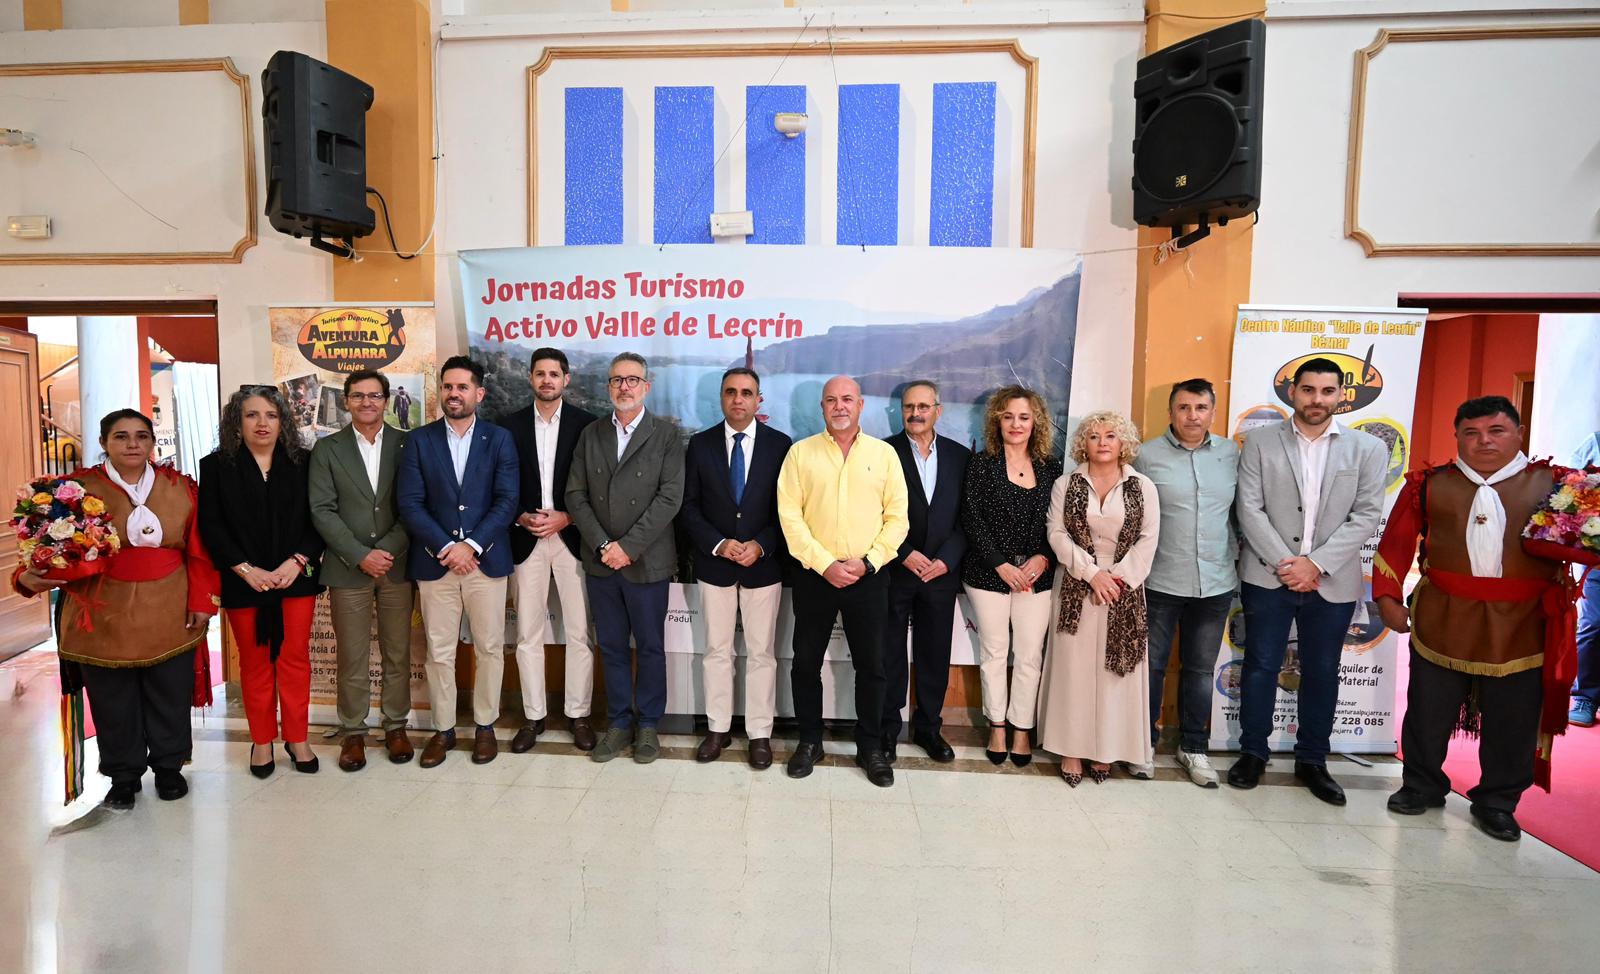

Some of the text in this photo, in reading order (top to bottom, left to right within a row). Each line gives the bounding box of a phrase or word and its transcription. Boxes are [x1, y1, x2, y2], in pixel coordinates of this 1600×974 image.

[481, 271, 745, 305] Jornadas Turismo
[322, 314, 379, 325] Turismo Deportivo
[1240, 318, 1279, 333] Centro
[1282, 318, 1326, 334] Náutico
[1364, 321, 1379, 335] de
[307, 324, 379, 341] AVENTURA
[484, 311, 803, 343] Activo Valle de Lecrín
[1311, 334, 1350, 350] Béznar
[312, 340, 387, 359] ALPUJARRA
[337, 362, 365, 372] Viajes
[668, 614, 692, 623] Padul
[1371, 664, 1383, 675] de
[1338, 675, 1379, 687] Material
[1341, 717, 1361, 725] 228
[1364, 717, 1384, 727] 085
